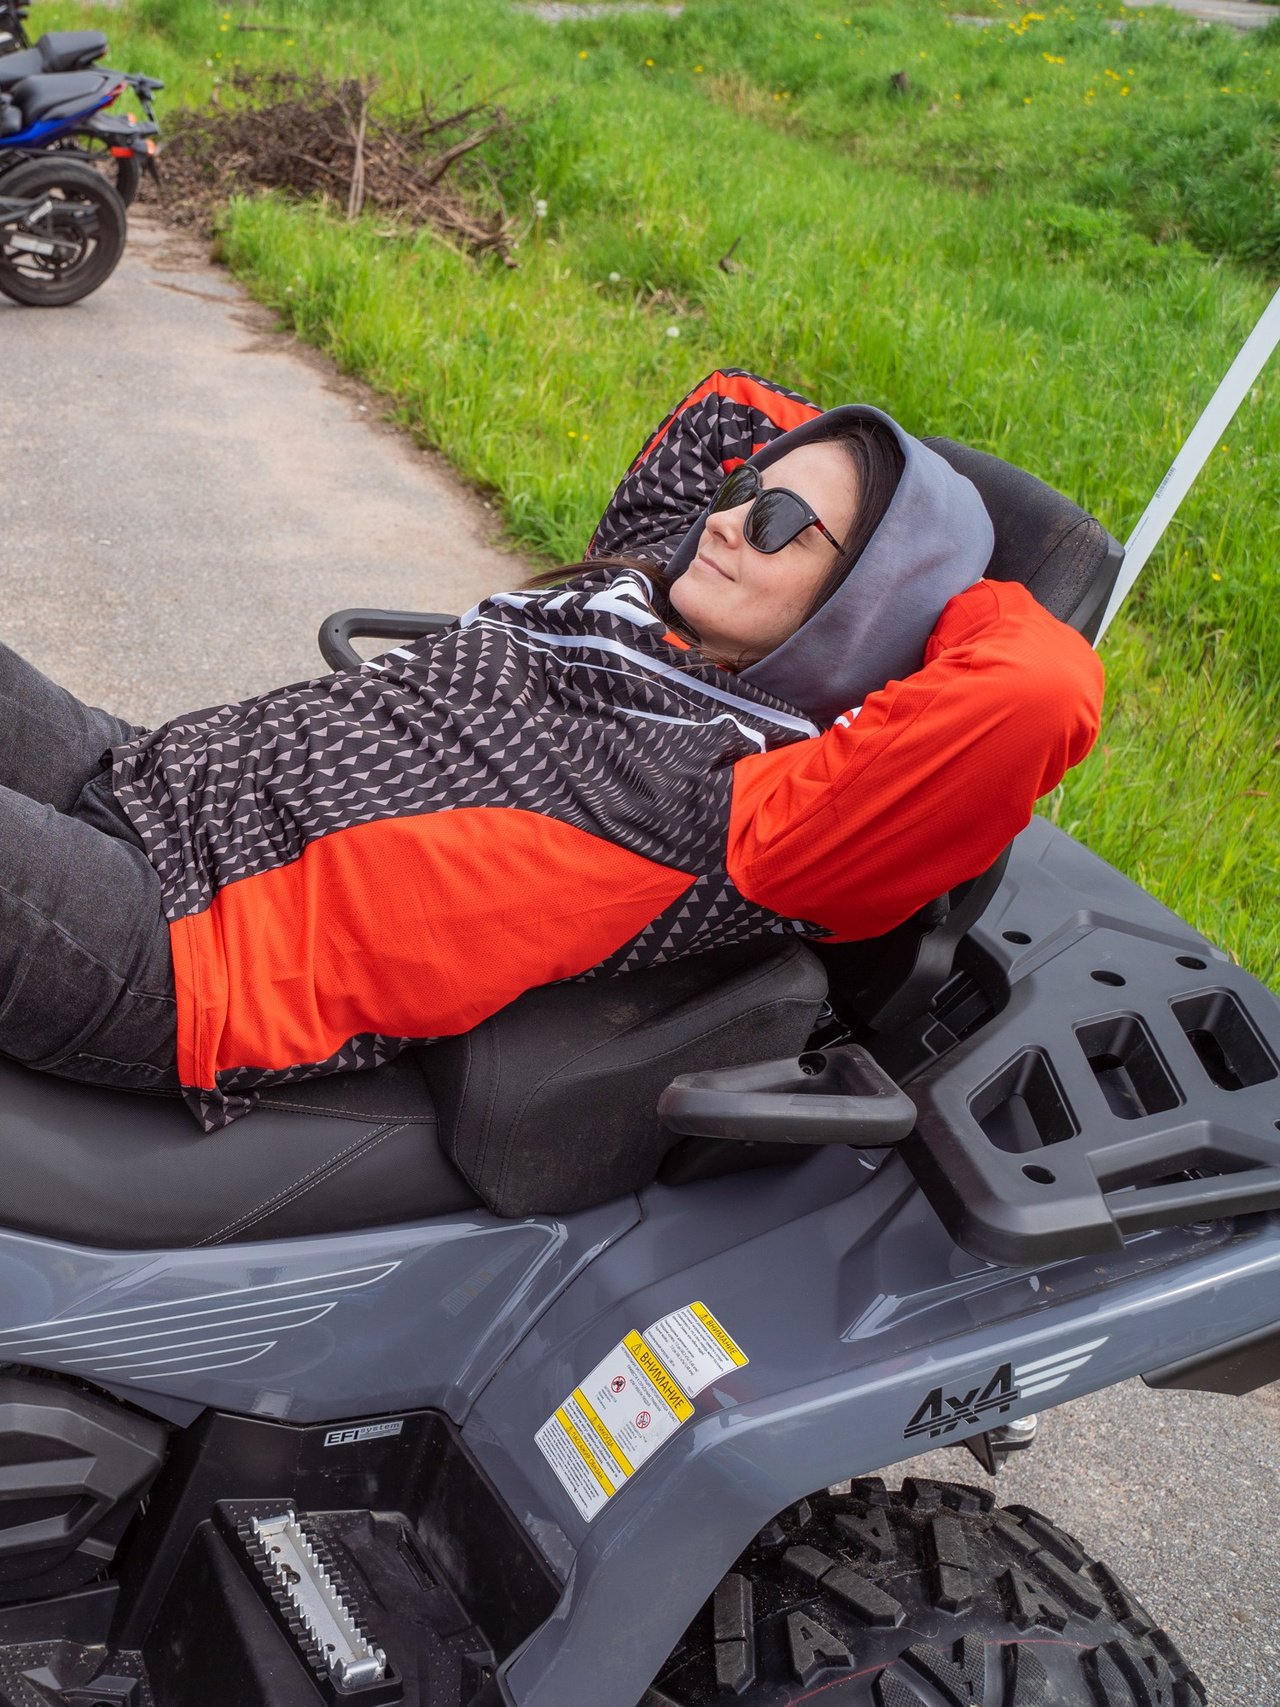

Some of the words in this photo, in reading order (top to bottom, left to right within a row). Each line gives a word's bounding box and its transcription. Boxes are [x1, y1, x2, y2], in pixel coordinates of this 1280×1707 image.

[706, 1319, 738, 1355] ВНИМАНИЕ
[639, 1351, 685, 1410] ВНИМАНИЕ
[326, 1429, 360, 1444] EFI
[360, 1422, 400, 1433] system
[570, 1431, 590, 1460] ПАССАЖИР
[596, 1423, 614, 1448] НИКОГДА
